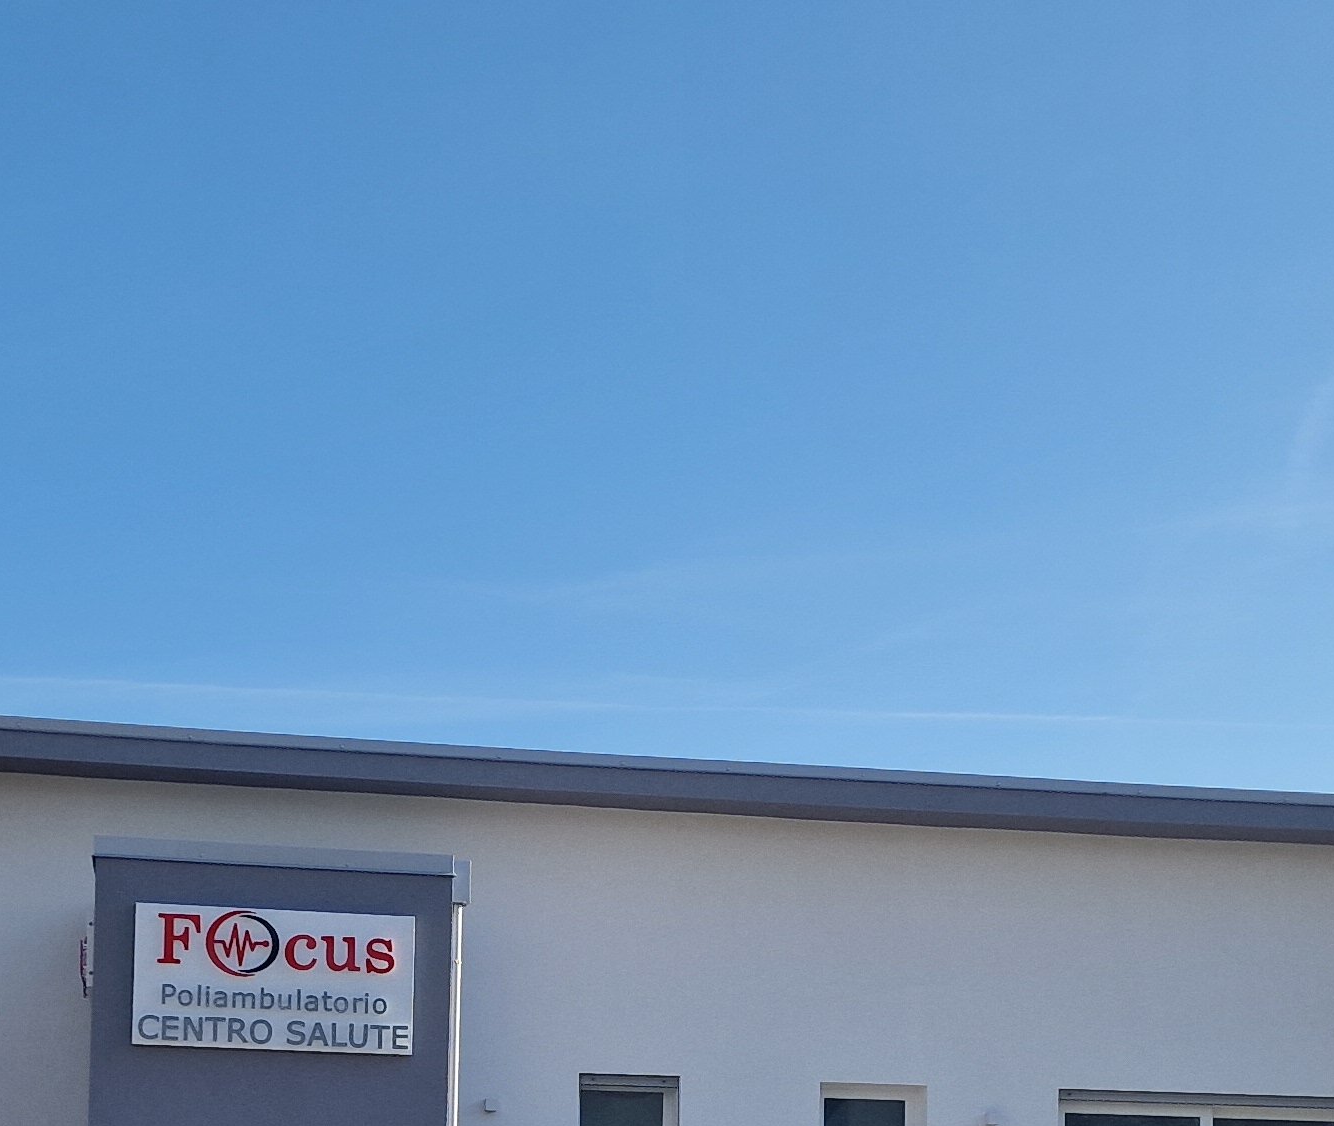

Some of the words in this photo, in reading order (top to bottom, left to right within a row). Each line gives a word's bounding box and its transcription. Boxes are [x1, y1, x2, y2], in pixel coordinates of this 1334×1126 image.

[160, 983, 388, 1015] Poliambulatorio
[137, 1014, 273, 1045] CENTRO
[286, 1020, 409, 1050] SALUTE
